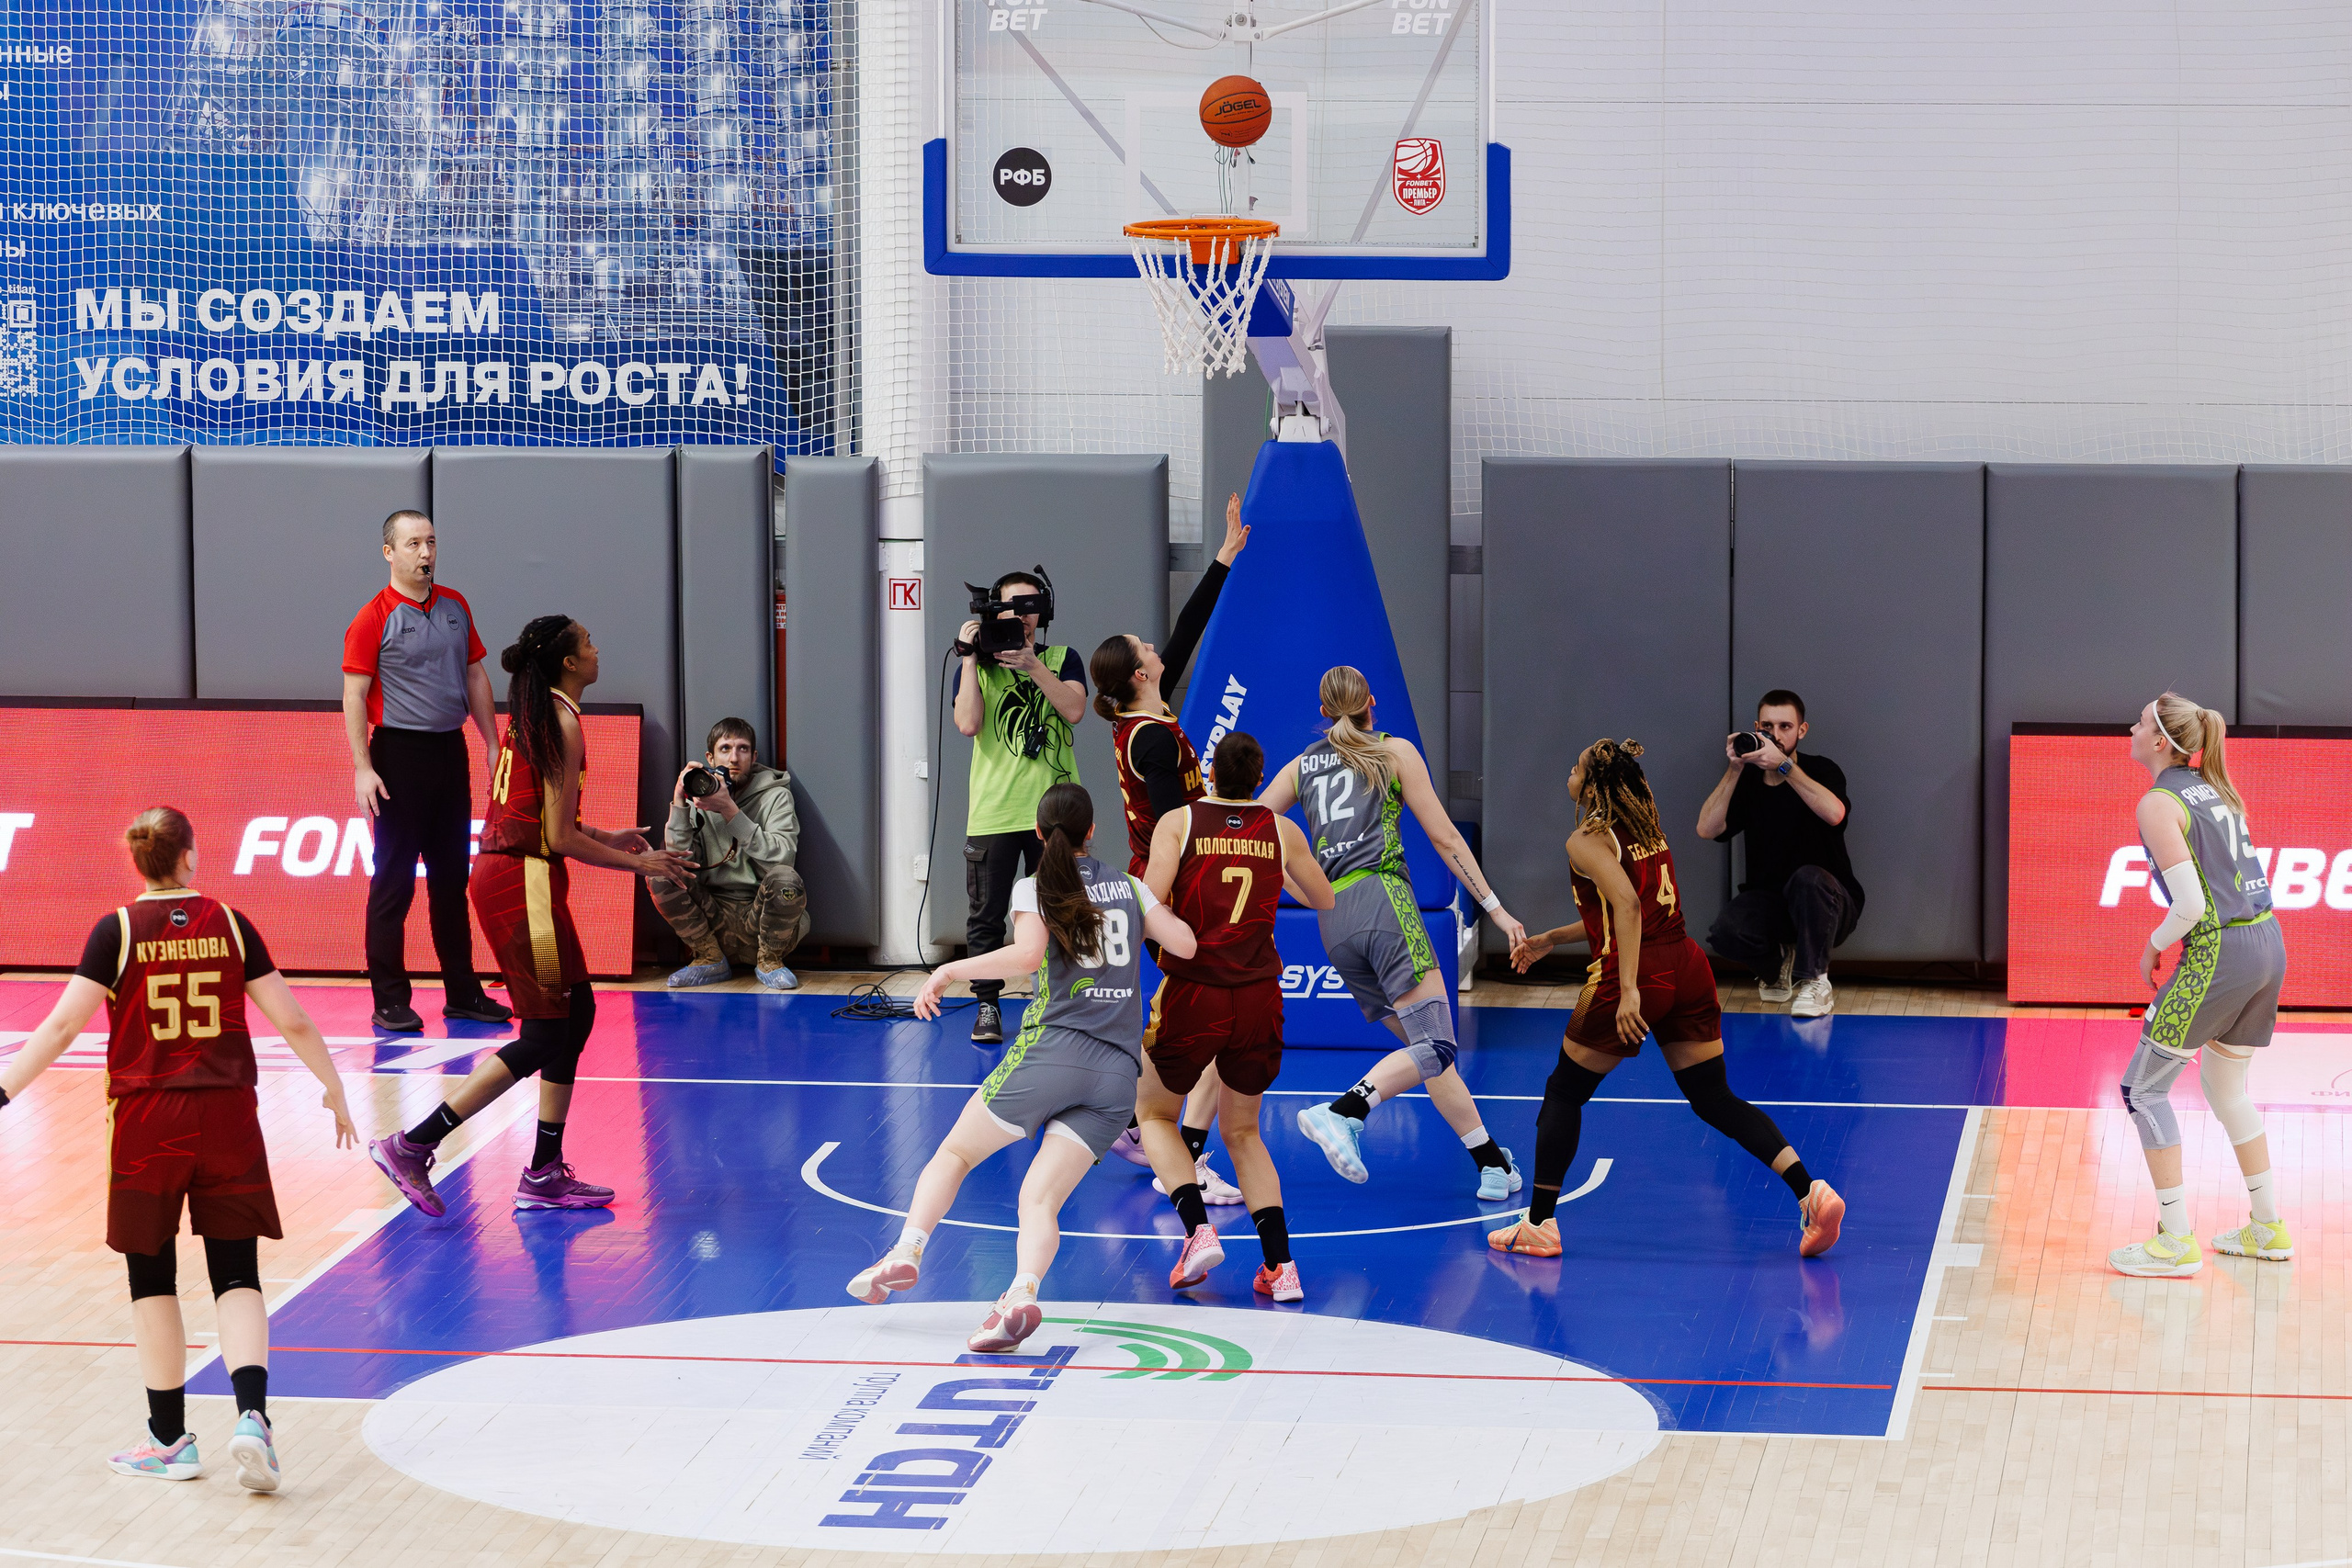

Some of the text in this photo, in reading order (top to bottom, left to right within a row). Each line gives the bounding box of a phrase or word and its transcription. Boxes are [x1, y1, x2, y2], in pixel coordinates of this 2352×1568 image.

[989, 8, 1048, 31] BET
[1391, 12, 1452, 35] BET
[1214, 99, 1262, 117] JÖGEL
[1000, 168, 1046, 186] РФБ
[1402, 187, 1438, 199] ПРЕМЬЕР
[13, 202, 162, 221] ключевых
[75, 288, 500, 341] МЫ СОЗДАЕМ
[74, 357, 749, 412] УСЛОВИЯ ДЛЯ РОСТА!
[893, 582, 917, 605] ПК
[1312, 768, 1355, 826] 12
[1195, 837, 1274, 860] КОЛОСОВСКАЯ
[1221, 866, 1253, 924] 7
[1657, 863, 1677, 918] 4
[136, 936, 230, 963] КУЗНЕЦОВА
[146, 971, 222, 1041] 55
[797, 1371, 902, 1461] группа компаний
